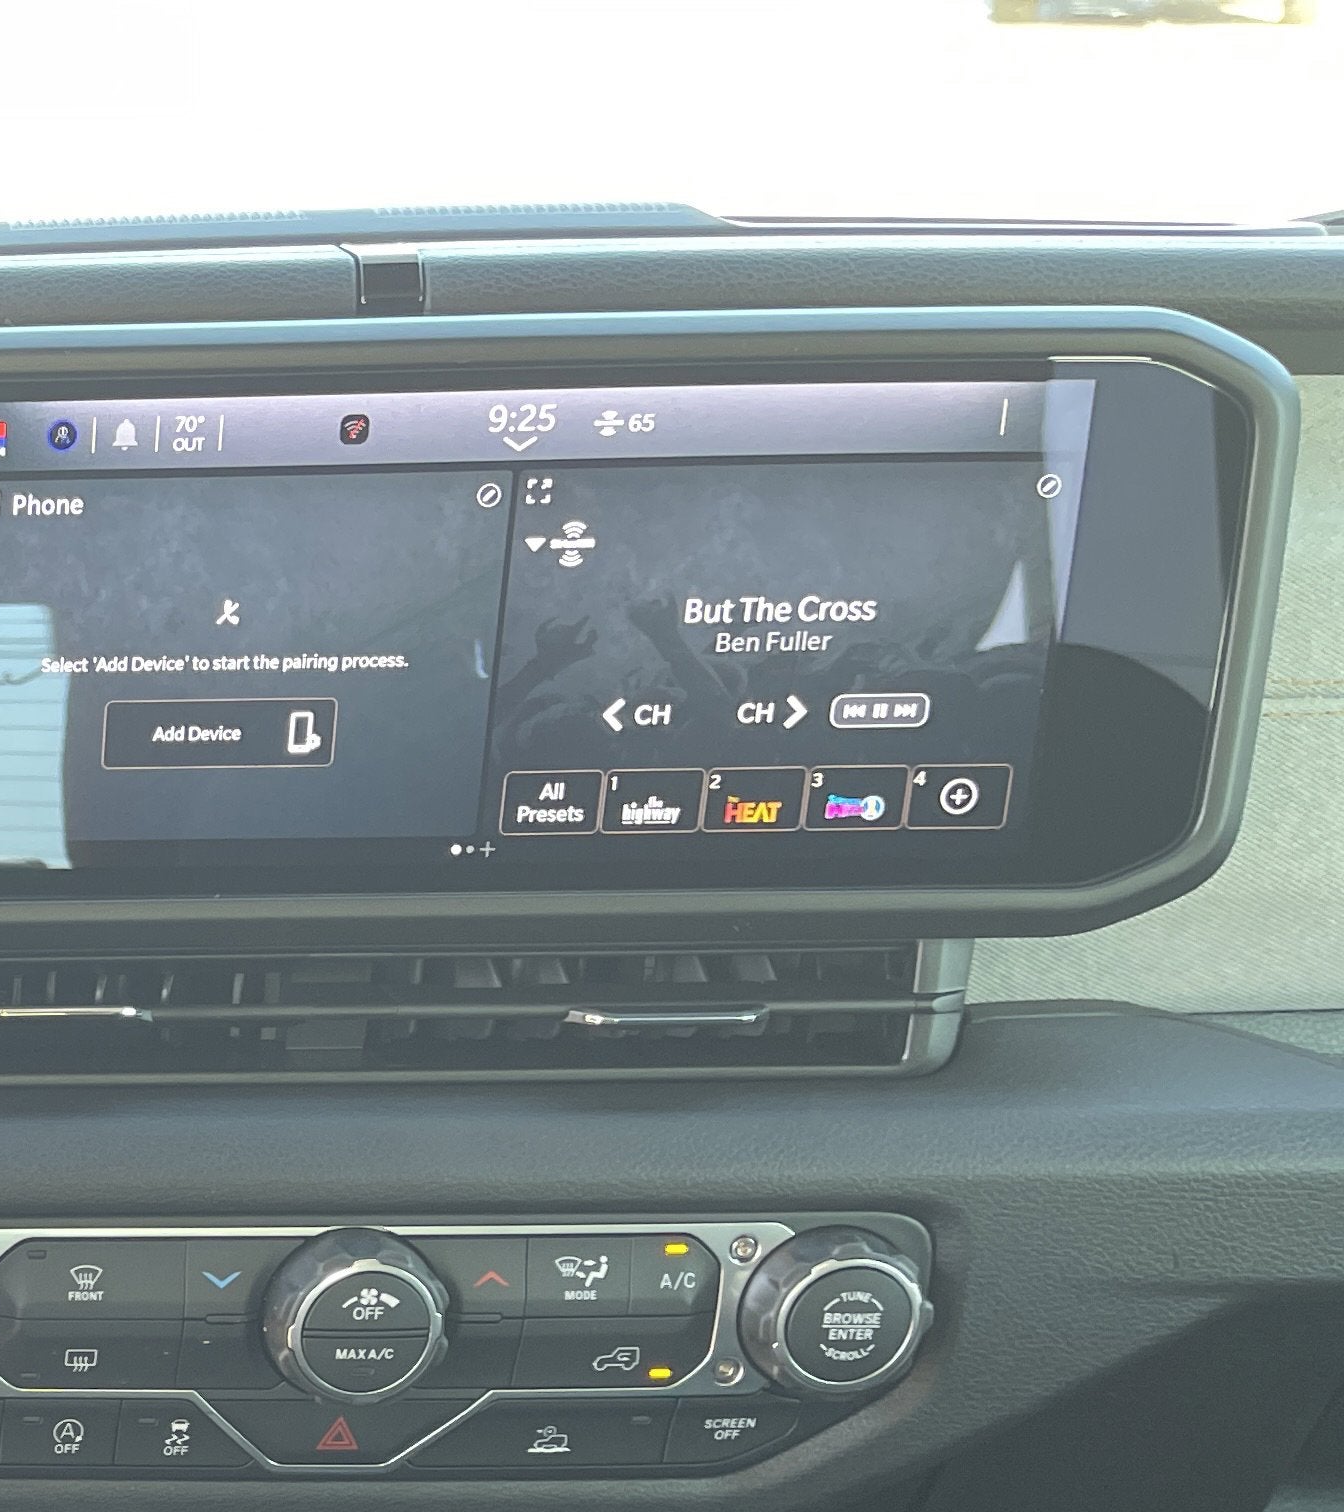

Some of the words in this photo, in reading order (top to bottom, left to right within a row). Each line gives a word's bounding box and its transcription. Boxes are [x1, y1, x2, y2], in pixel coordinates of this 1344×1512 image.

[174, 415, 206, 433] 70°
[488, 404, 559, 433] 9:25
[628, 413, 656, 433] 65
[172, 437, 206, 452] OUT
[12, 494, 85, 517] Phone
[684, 598, 735, 624] But
[740, 596, 793, 622] The
[797, 595, 877, 621] Cross
[715, 632, 761, 653] Ben
[765, 631, 833, 652] Fuller
[40, 656, 89, 674] Select
[192, 656, 210, 671] to
[212, 655, 251, 671] start
[253, 654, 280, 670] the
[282, 653, 339, 674] pairing
[341, 655, 409, 672] process.
[634, 704, 671, 726] CH
[737, 702, 774, 724] CH
[152, 725, 185, 741] Add
[188, 725, 242, 741] Device
[610, 775, 619, 791] 1
[709, 774, 722, 790] 2
[811, 772, 825, 788] 3
[912, 770, 928, 787] 4
[538, 782, 566, 801] All
[516, 805, 586, 824] Presets
[621, 801, 681, 825] highway
[723, 799, 783, 824] HEAT
[659, 1272, 697, 1291] A/C
[67, 1290, 104, 1301] FRONT
[564, 1290, 598, 1301] MODE
[840, 1291, 873, 1303] TUNE
[352, 1307, 385, 1321] OFF
[823, 1312, 882, 1325] BROWSE
[828, 1328, 874, 1341] ENTER
[335, 1349, 367, 1361] MAX
[367, 1347, 395, 1361] A/C
[825, 1347, 870, 1361] SCROLL
[703, 1417, 757, 1430] SCREEN
[714, 1429, 742, 1441] OFF
[54, 1443, 80, 1455] OFF
[163, 1445, 189, 1456] OFF
